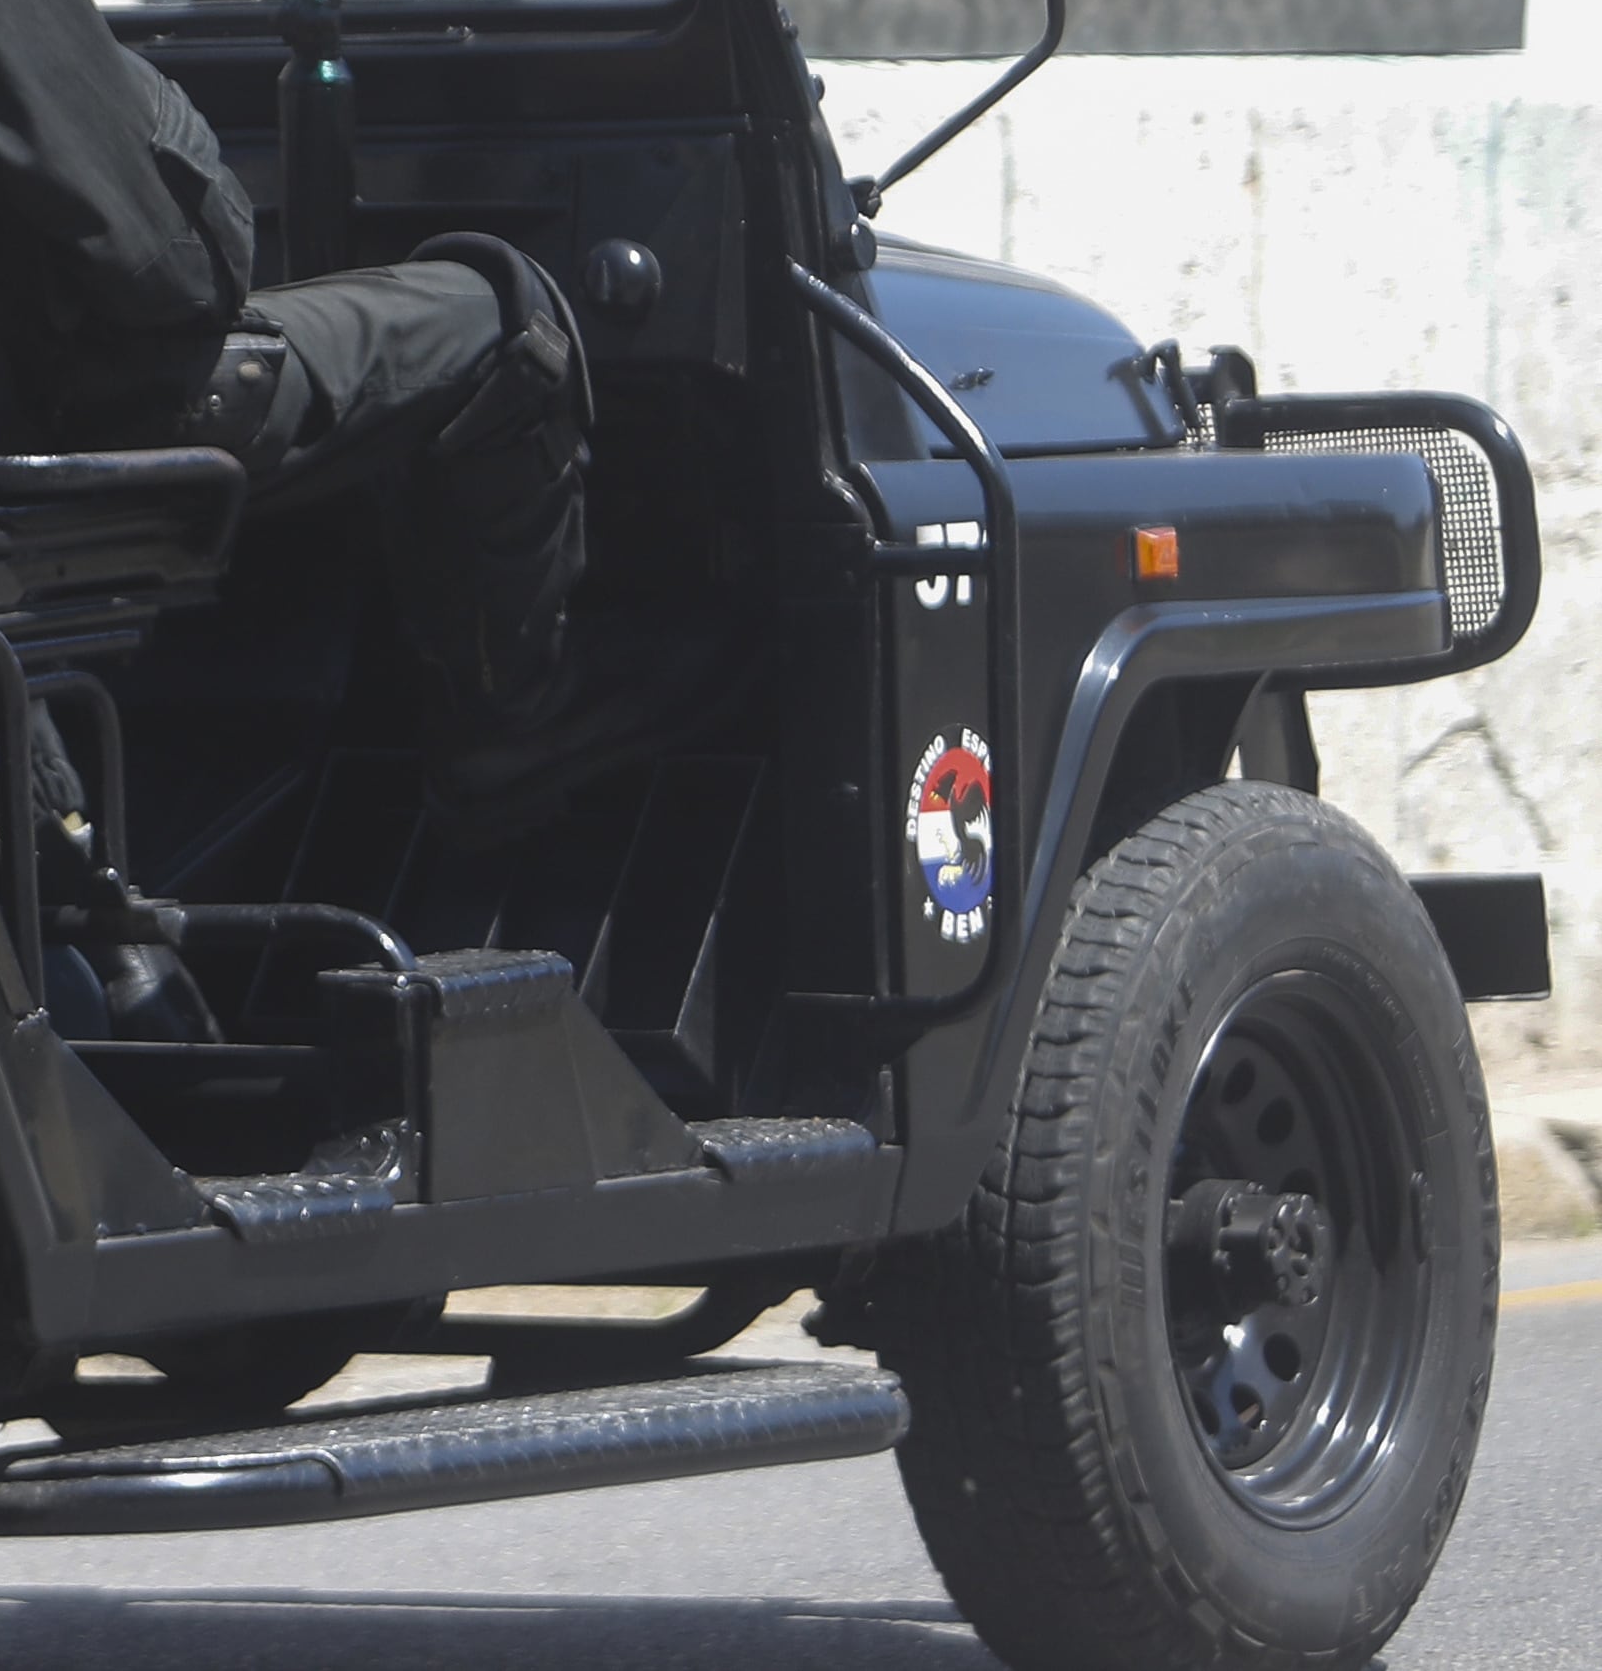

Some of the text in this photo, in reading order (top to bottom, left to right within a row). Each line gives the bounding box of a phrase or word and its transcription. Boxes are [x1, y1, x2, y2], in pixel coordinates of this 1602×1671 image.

[915, 520, 987, 610] 57
[905, 734, 946, 842] DESTINO
[940, 906, 985, 943] BEN
